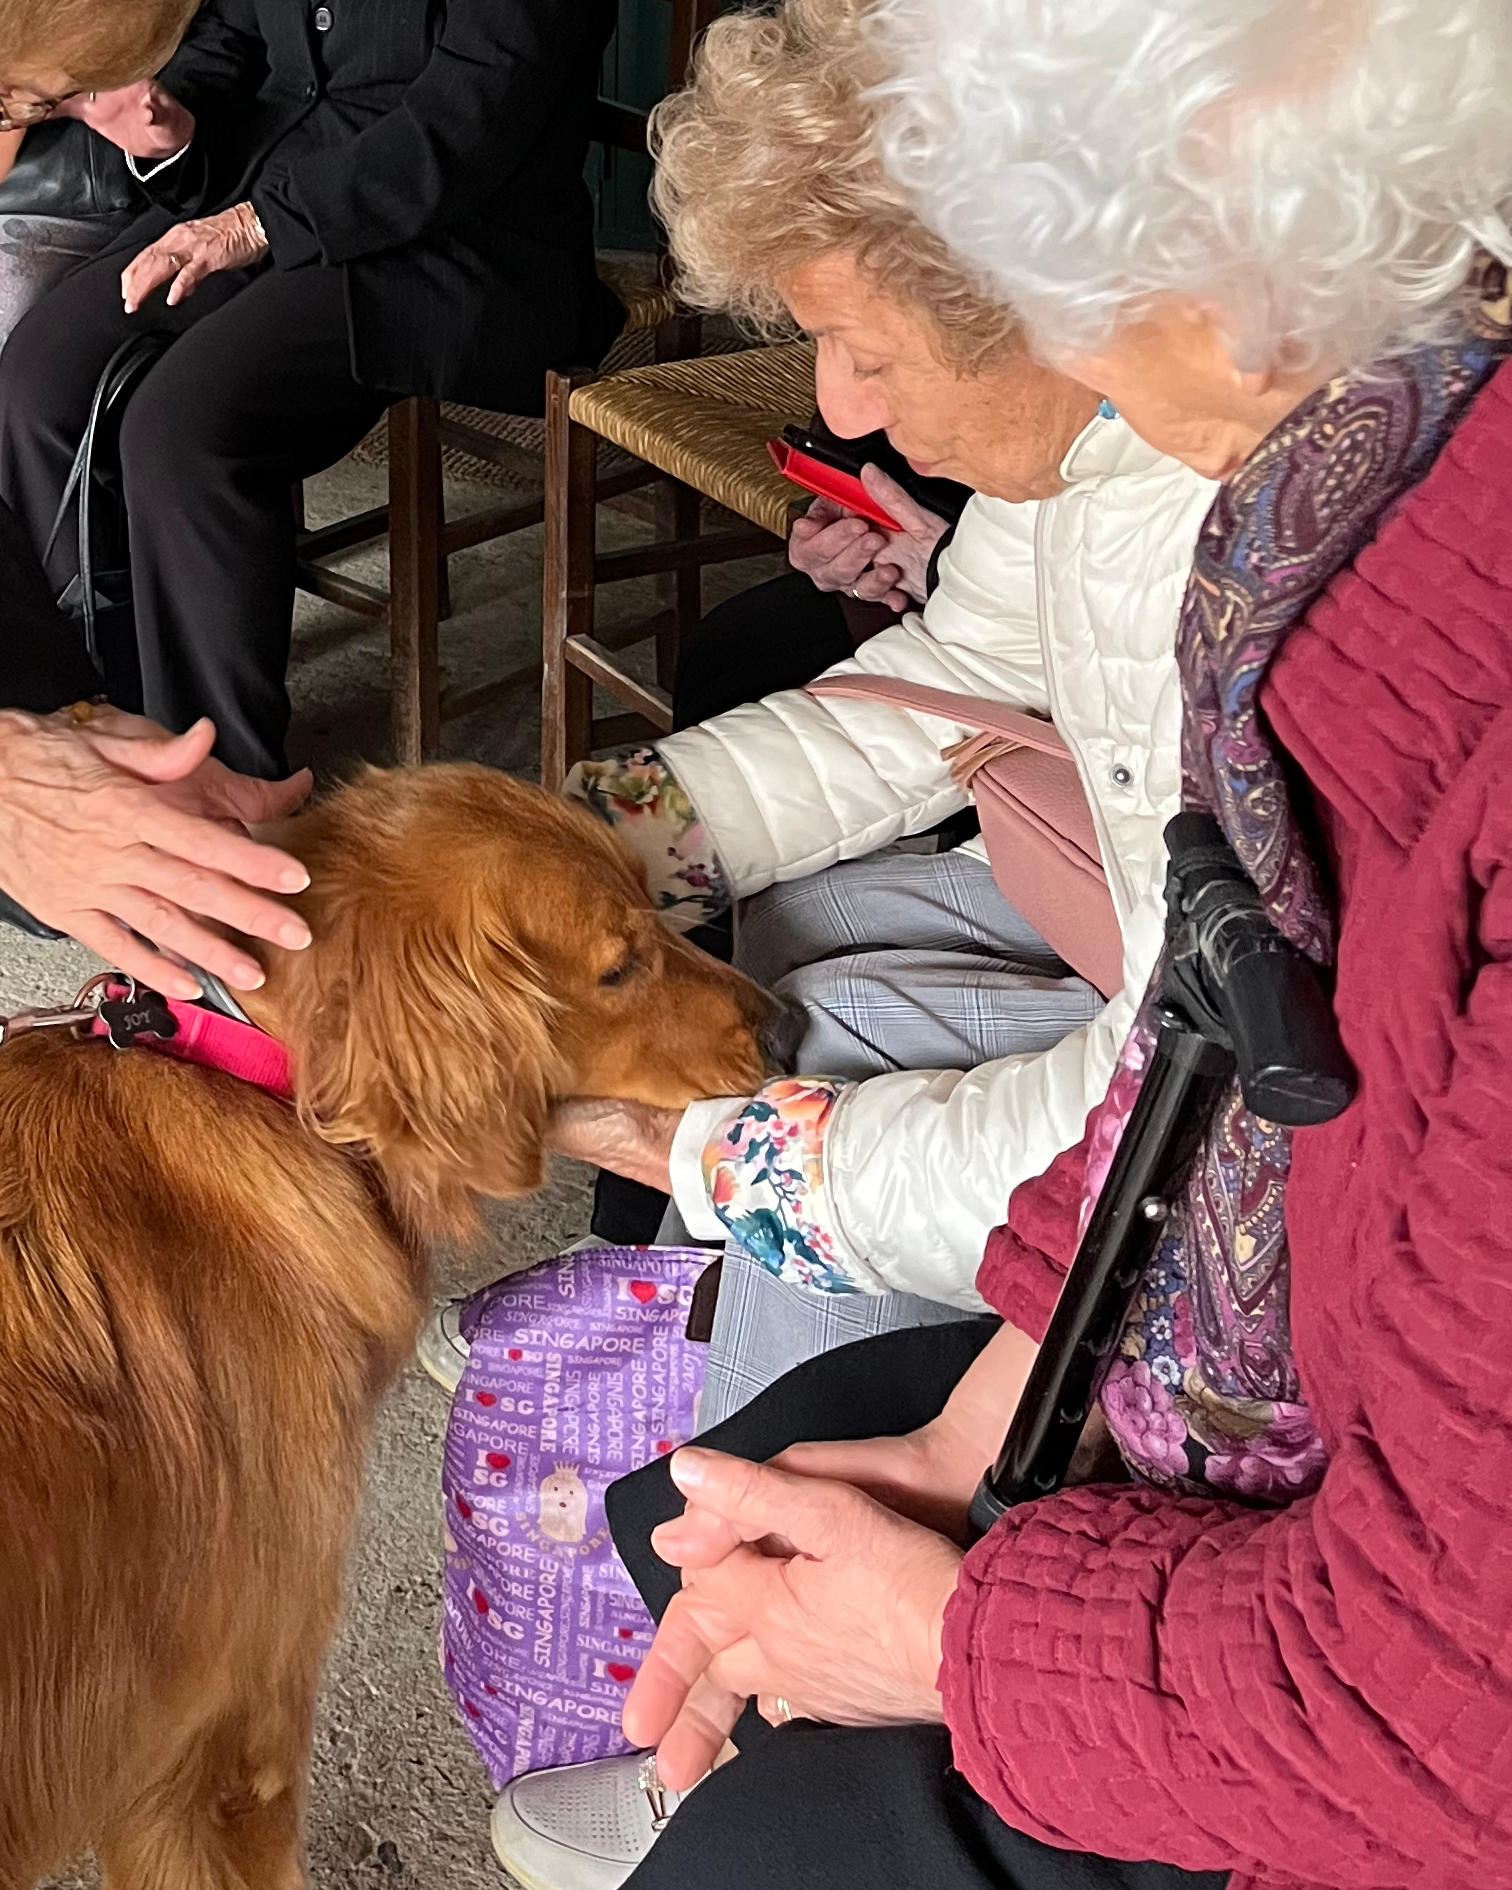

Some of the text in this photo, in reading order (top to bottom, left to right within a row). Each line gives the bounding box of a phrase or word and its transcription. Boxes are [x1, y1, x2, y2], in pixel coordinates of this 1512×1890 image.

[123, 1009, 153, 1031] JOY
[616, 1277, 631, 1301] I
[657, 1283, 694, 1307] SG
[513, 1328, 646, 1355] SINGAPORE
[651, 1325, 669, 1435] SINGAPORE
[681, 1352, 702, 1394] love
[465, 1388, 536, 1416] I SG
[540, 1351, 563, 1453] SINGAPORE
[586, 1371, 601, 1466] SINGAPORE
[606, 1367, 624, 1463] SINGAPORE
[631, 1358, 648, 1471] SINGAPORE
[452, 1406, 538, 1440] SINGAPORE
[476, 1448, 489, 1468] I
[472, 1468, 509, 1488] SG
[472, 1511, 511, 1538] SG
[515, 1511, 609, 1560] SINGAPORE
[487, 1608, 525, 1641] SG
[534, 1558, 560, 1668] SINGAPORE
[591, 1658, 607, 1679] I
[489, 1673, 623, 1727] SINGAPORE
